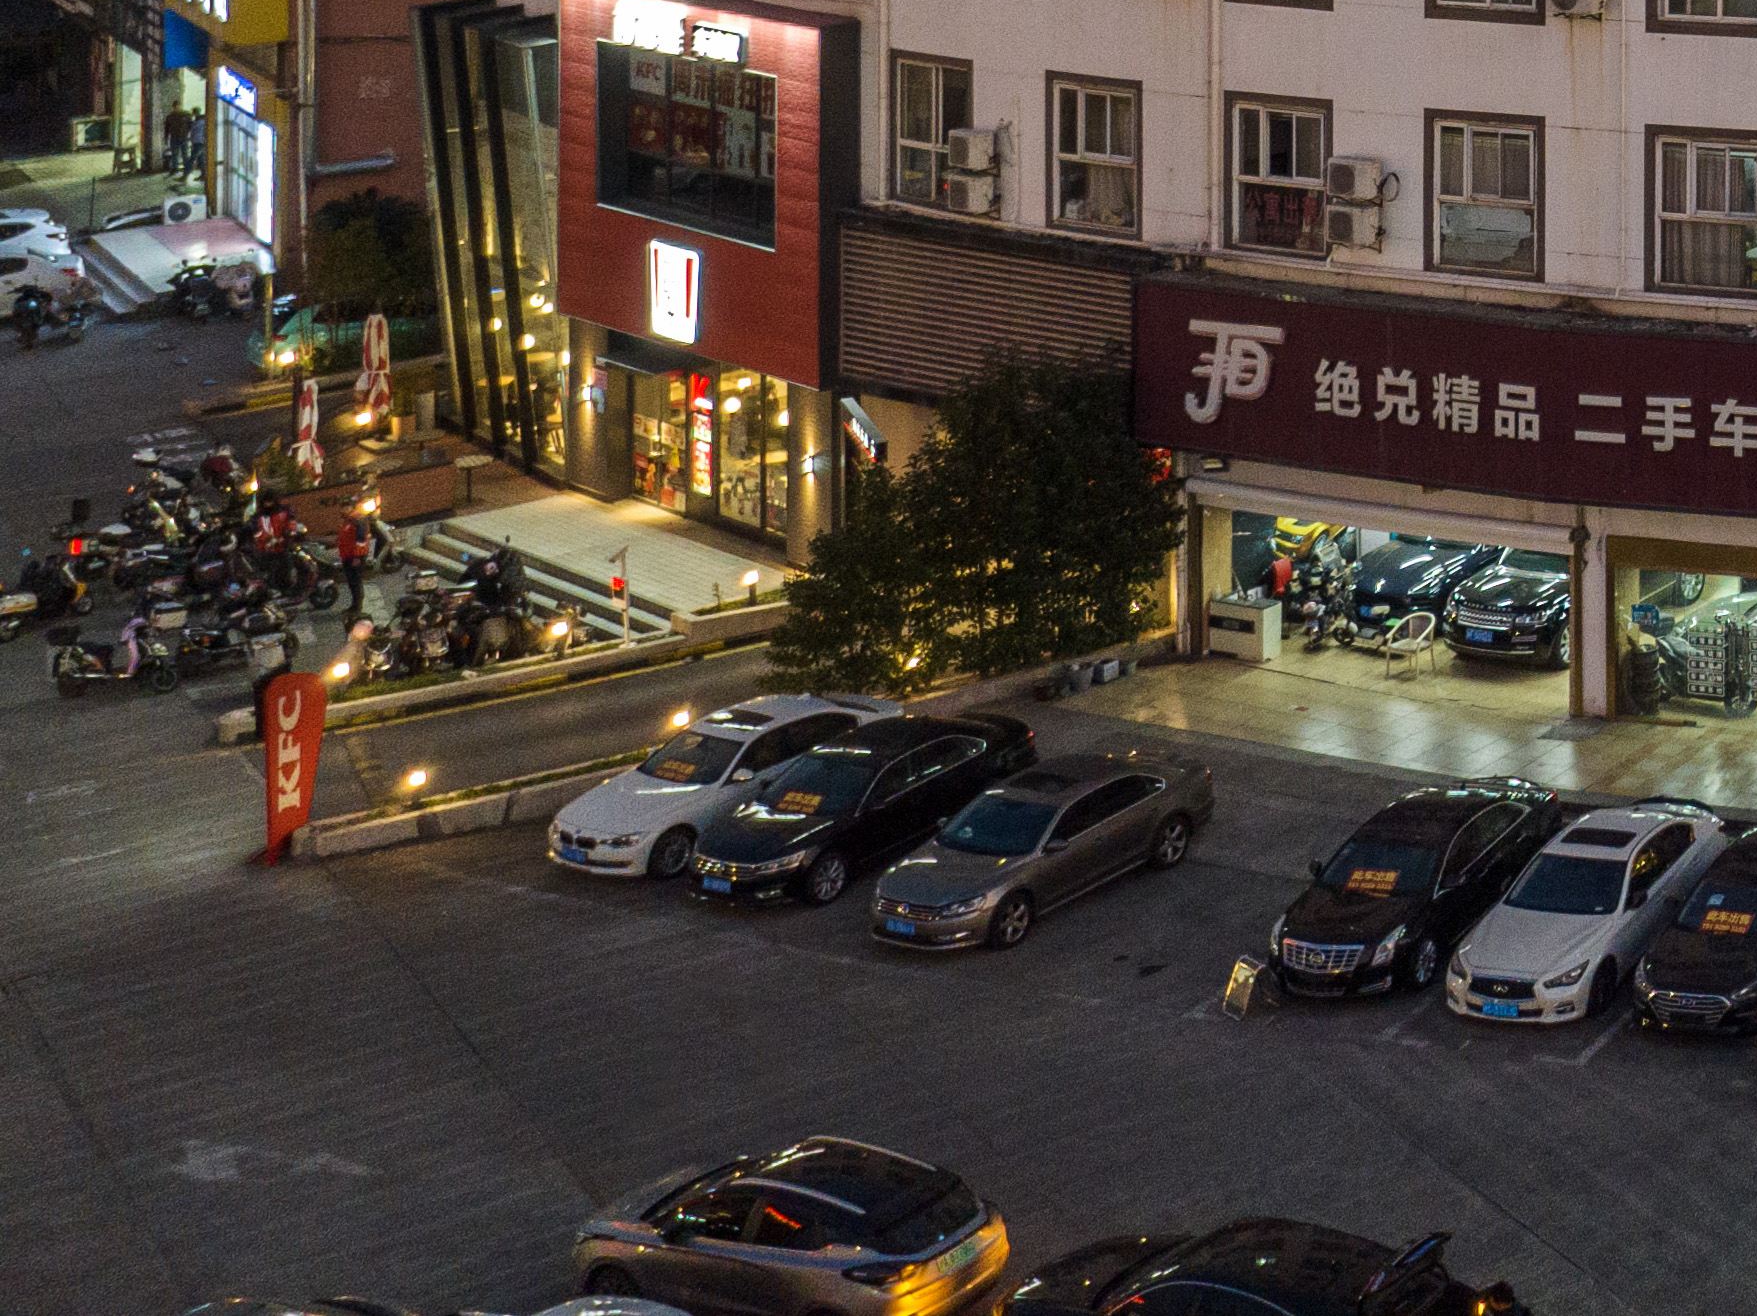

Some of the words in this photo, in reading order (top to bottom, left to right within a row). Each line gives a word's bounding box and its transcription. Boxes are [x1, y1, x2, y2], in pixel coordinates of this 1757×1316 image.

[1314, 358, 1542, 444] 绝兑精品
[277, 689, 301, 814] KFC
